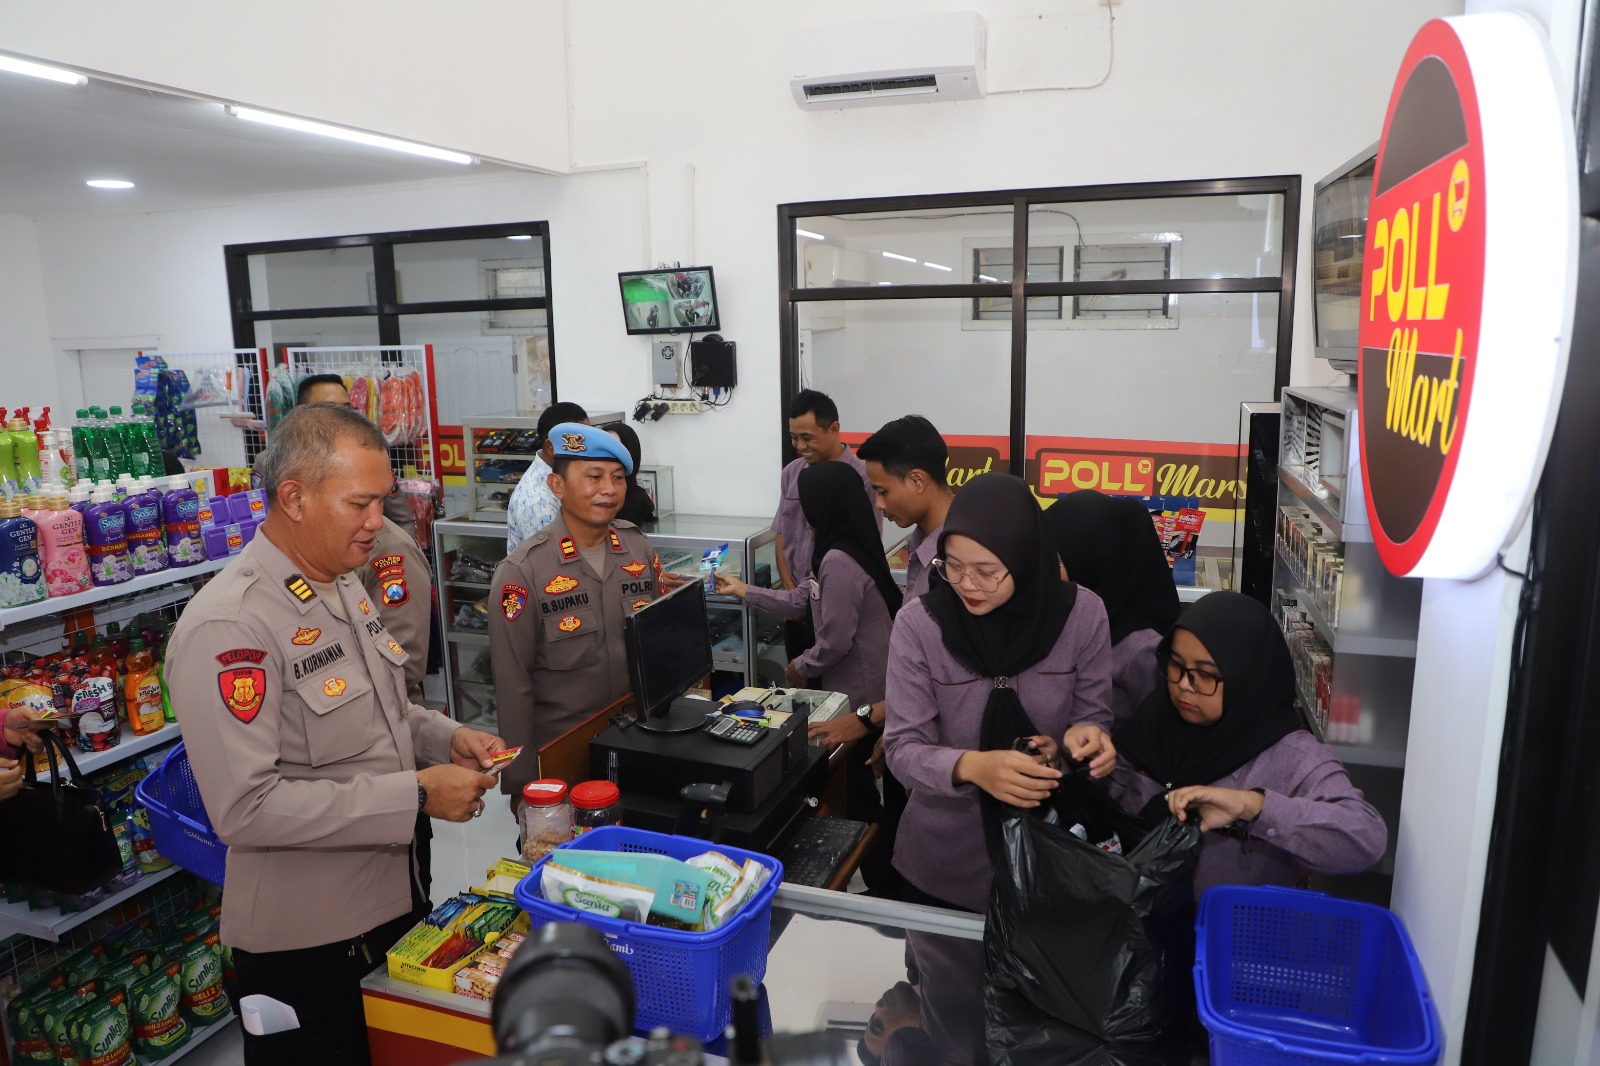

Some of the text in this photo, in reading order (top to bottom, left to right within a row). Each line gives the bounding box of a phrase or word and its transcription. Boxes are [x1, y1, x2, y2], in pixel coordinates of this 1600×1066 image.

[1370, 192, 1450, 322] POLL
[1386, 327, 1463, 456] Mart
[1043, 459, 1146, 492] POLL
[10, 527, 36, 538] GENTLE
[53, 520, 82, 531] GENTLE
[61, 527, 78, 535] GEN
[18, 535, 33, 543] GEN
[541, 592, 589, 614] B.SUPAKU
[221, 650, 262, 663] PELOPOR
[293, 642, 346, 680] B.KURNIAWAN
[573, 893, 610, 913] Sania
[400, 962, 427, 973] VITACIMIN
[192, 987, 216, 1002] BELI 2
[93, 1018, 128, 1056] Sunlight
